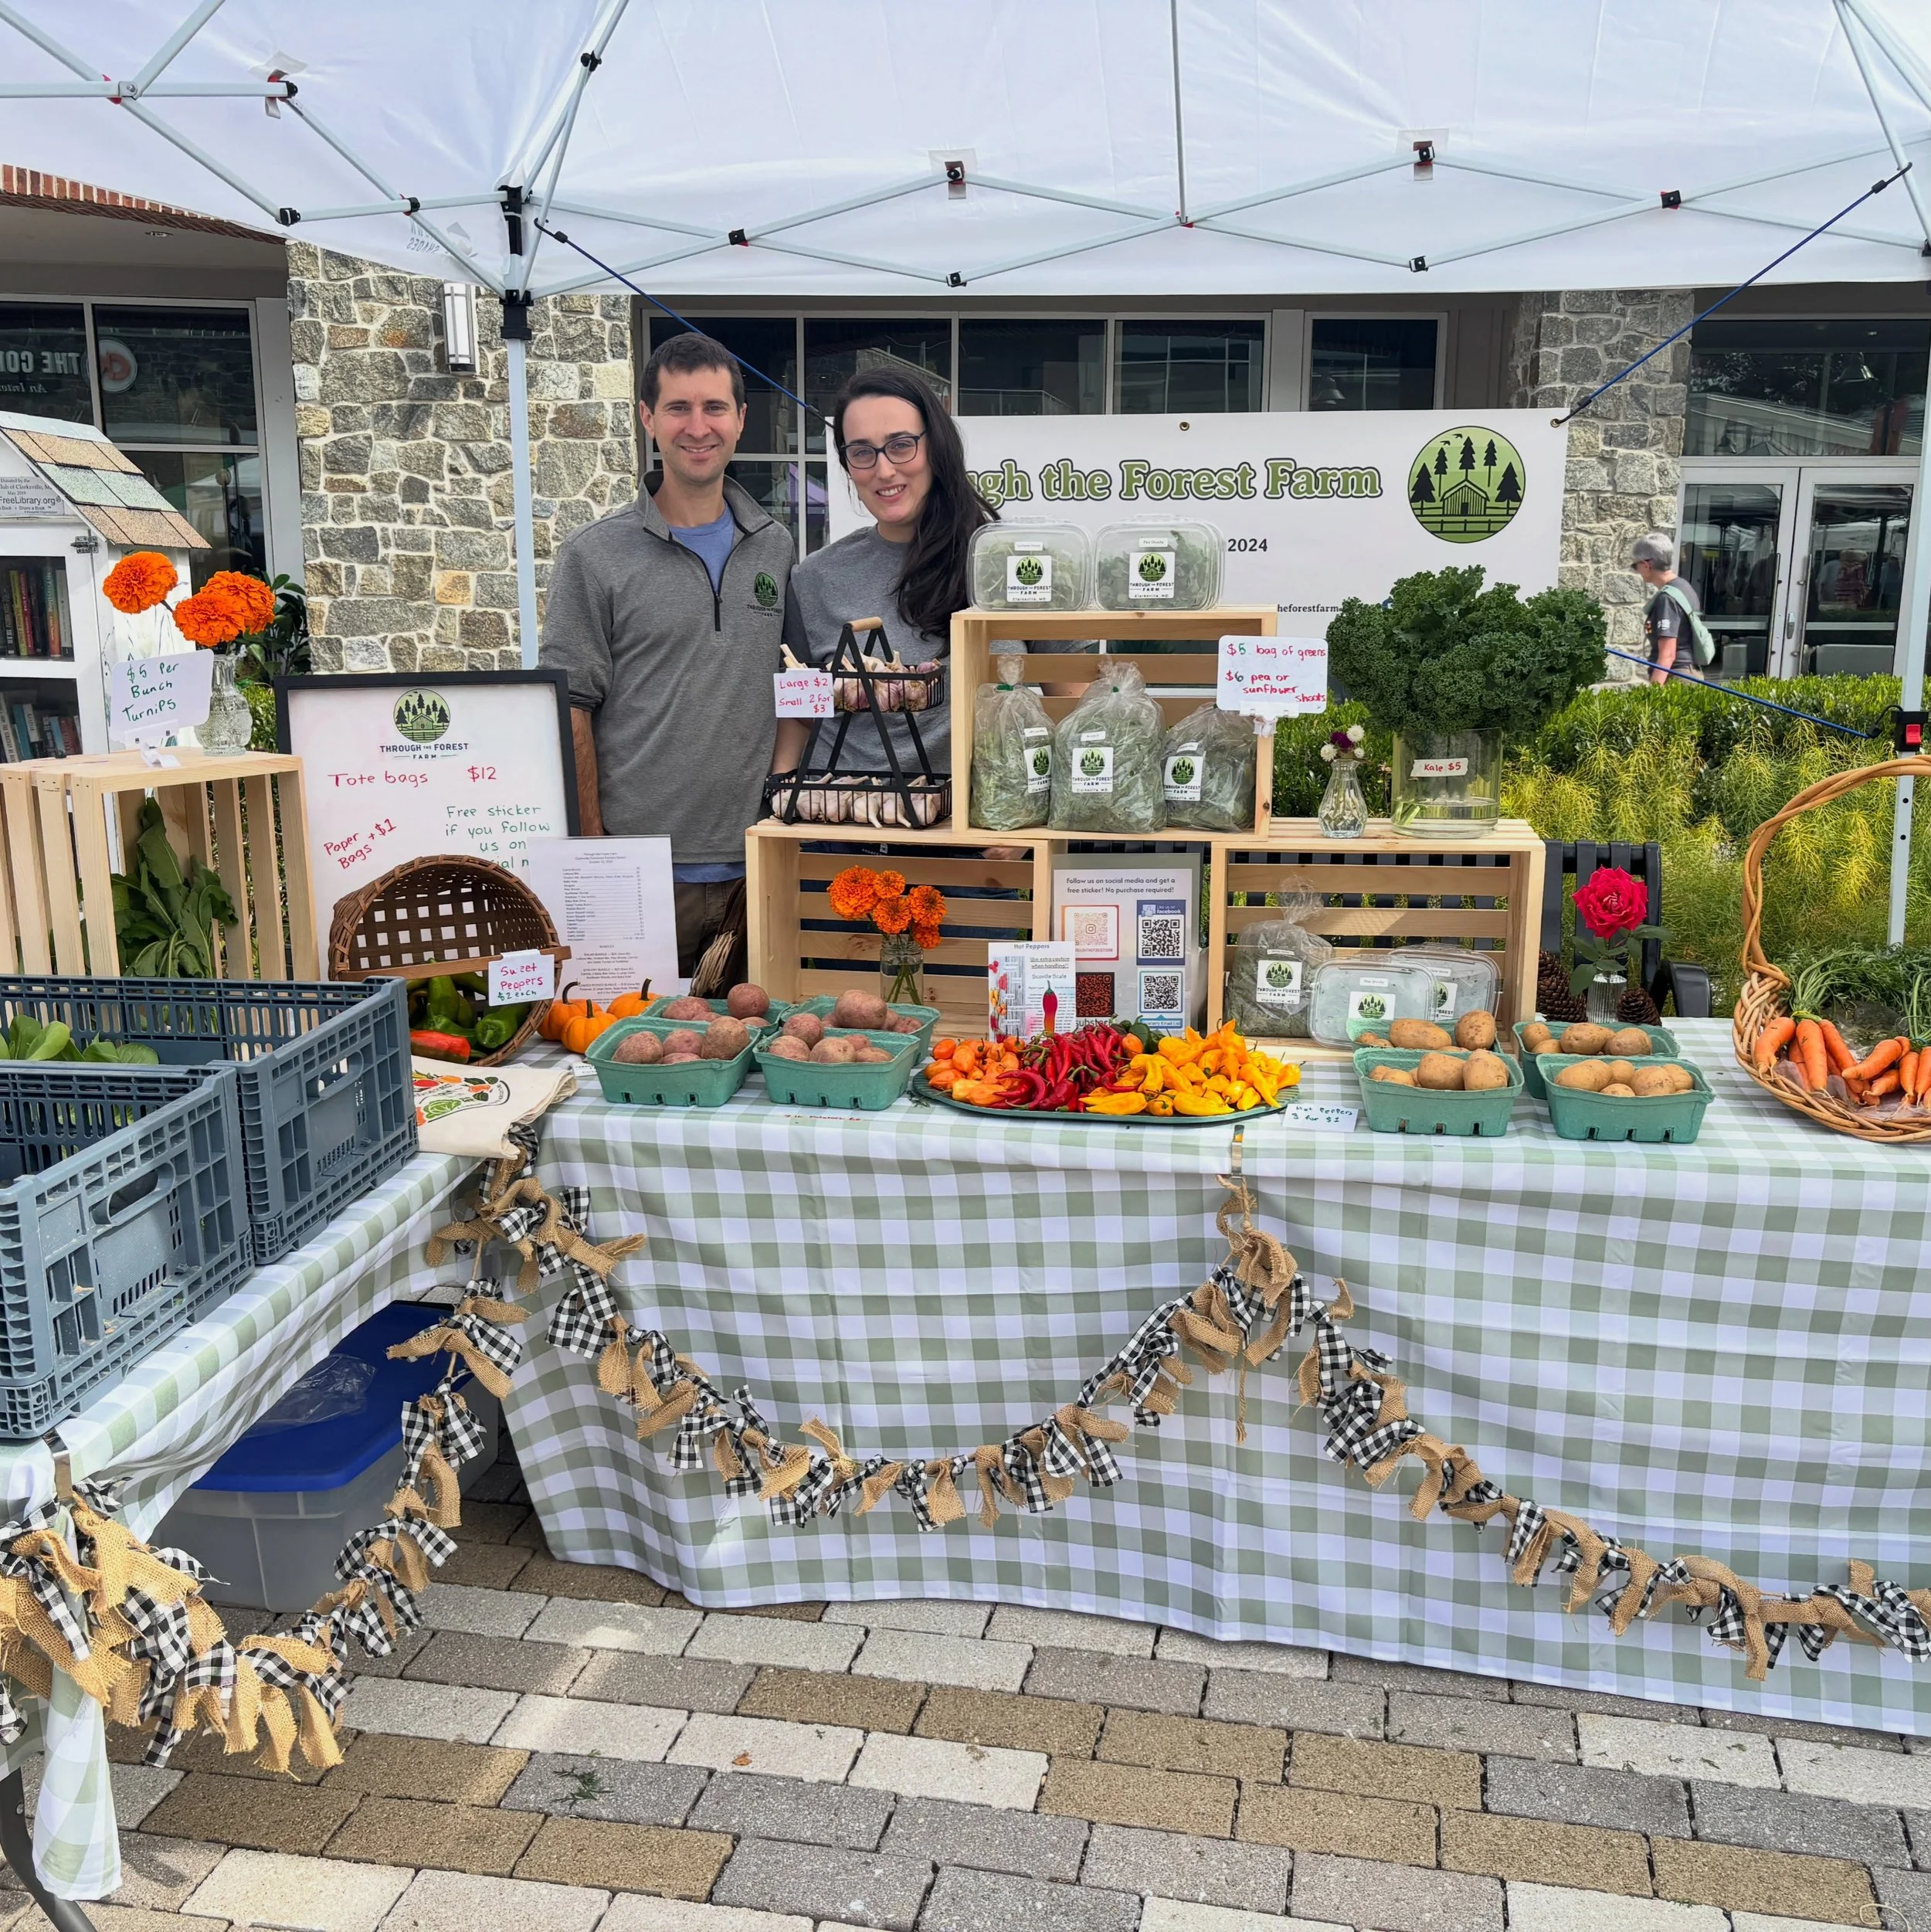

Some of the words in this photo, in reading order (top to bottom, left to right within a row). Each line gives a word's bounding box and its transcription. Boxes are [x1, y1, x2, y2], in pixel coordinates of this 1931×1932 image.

[1040, 458, 1111, 501] the
[1119, 460, 1257, 501] Forest
[1264, 457, 1383, 500] Farm
[1227, 538, 1268, 552] 2024
[1277, 603, 1342, 613] heforestfarm
[1227, 643, 1247, 656] $5
[1257, 645, 1277, 658] bag
[1282, 646, 1294, 655] of
[1298, 649, 1326, 660] greens
[127, 664, 147, 684] $5
[1225, 671, 1244, 683] $6
[1251, 674, 1271, 684] pea
[131, 681, 172, 698] Bunch
[779, 680, 809, 690] Large
[813, 677, 828, 688] $2
[1242, 684, 1298, 694] sunflower
[779, 698, 803, 707] Small
[809, 694, 815, 703] 2
[1295, 693, 1326, 702] shoots
[813, 704, 826, 713] $3
[380, 744, 422, 753] THROUGH
[1424, 763, 1444, 772] Kale
[1447, 762, 1461, 771] $5
[327, 773, 375, 786] Tote
[385, 770, 428, 788] bags
[467, 766, 497, 783] $12
[446, 806, 477, 818] Free
[487, 804, 541, 817] sticker
[446, 823, 458, 836] if
[468, 827, 492, 839] you
[324, 832, 360, 856] Paper
[480, 841, 499, 851] us
[509, 840, 526, 850] on
[338, 844, 373, 870] Bags
[501, 976, 543, 991] Peppers
[497, 992, 512, 1001] $2
